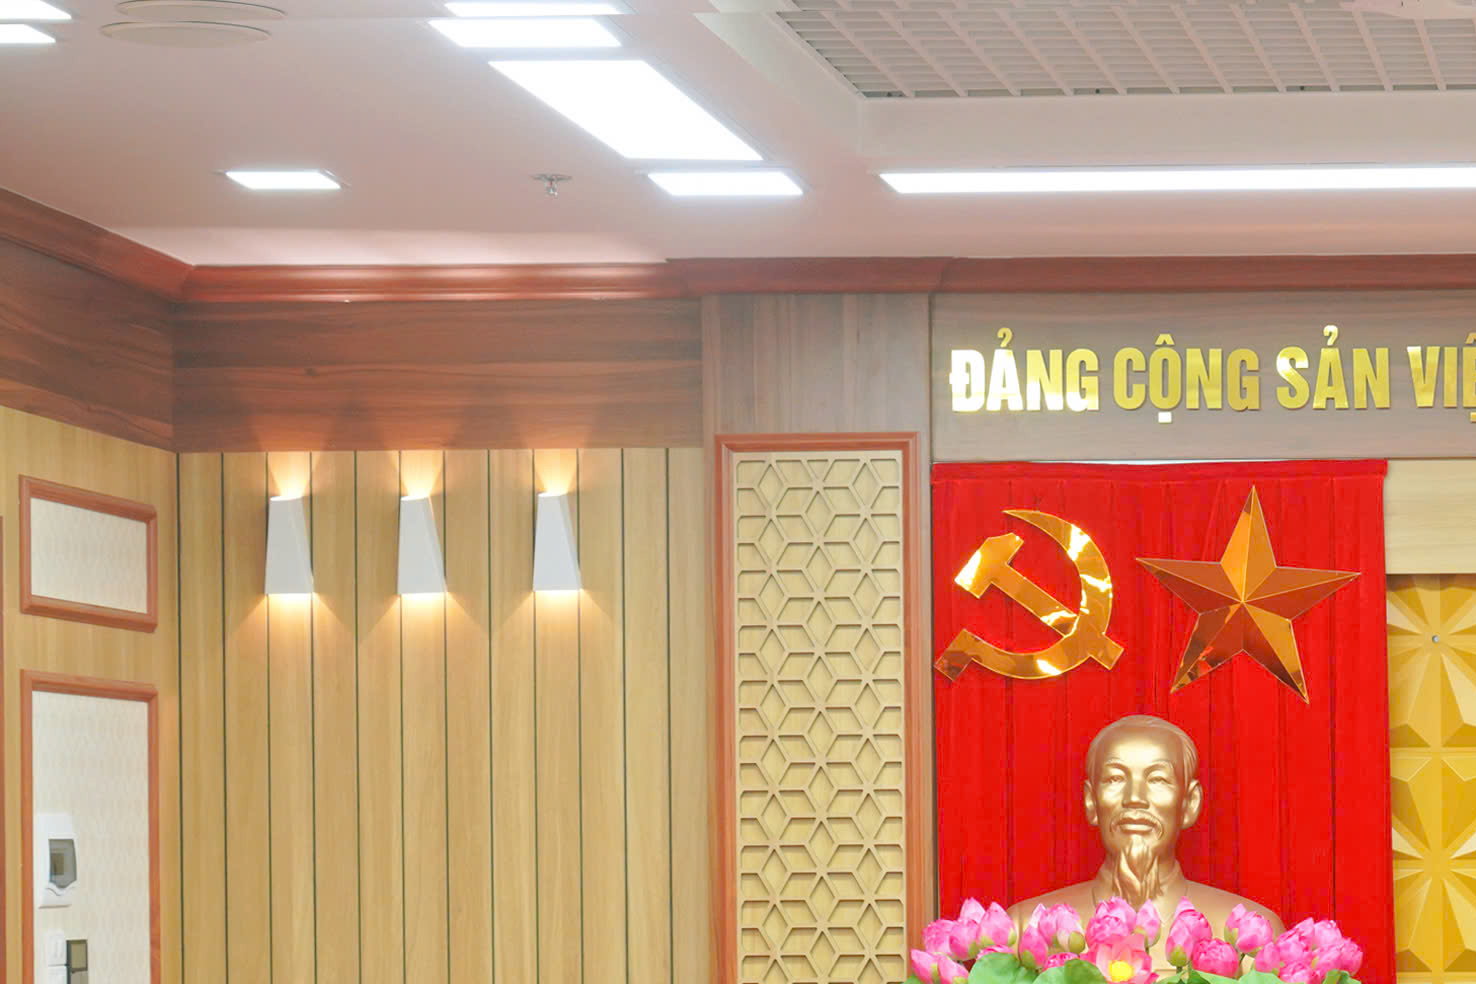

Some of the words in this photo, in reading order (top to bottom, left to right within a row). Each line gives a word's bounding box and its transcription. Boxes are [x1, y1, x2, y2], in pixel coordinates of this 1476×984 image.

[949, 327, 1099, 413] ĐẢNG
[1112, 333, 1261, 423] CỘNG
[1276, 325, 1392, 410] SẢN
